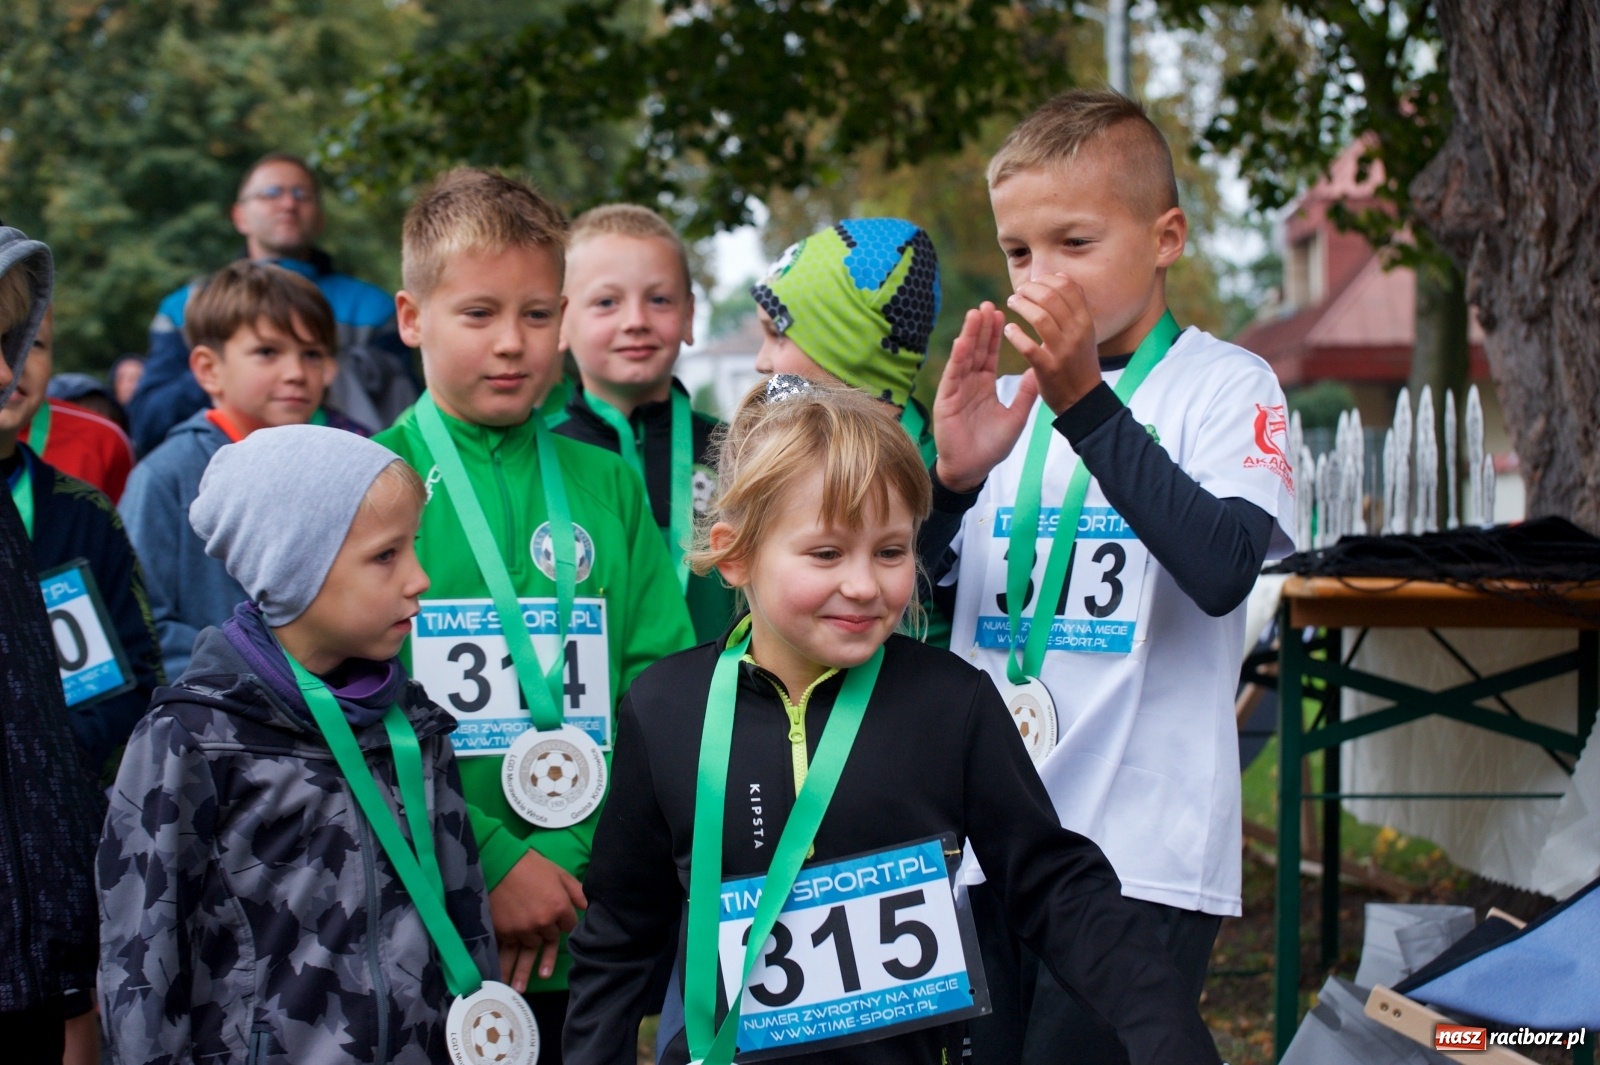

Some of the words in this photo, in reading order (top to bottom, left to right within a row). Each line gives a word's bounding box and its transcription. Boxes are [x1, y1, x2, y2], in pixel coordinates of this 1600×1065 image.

[1000, 514, 1131, 532] TE-SORT.P
[421, 610, 598, 631] TIME-SOR.PL
[982, 621, 1012, 631] NUME
[1021, 622, 1077, 633] ZTNY
[1076, 624, 1092, 634] NA
[1094, 625, 1128, 636] MECIE
[47, 609, 88, 671] 0
[996, 634, 1108, 648] WWWE-SPORT.PL
[447, 640, 586, 713] 34
[481, 722, 533, 734] ZWROT
[526, 807, 548, 823] Wrota
[570, 801, 593, 820] Gmina
[749, 783, 764, 849] KIPSTA
[720, 854, 938, 914] TIMSPORT.PL
[741, 889, 939, 1008] 315
[743, 1012, 799, 1031] NUMER
[802, 996, 882, 1021] ZWROTNY
[885, 989, 910, 1005] NA
[912, 977, 959, 998] MECIE
[769, 999, 938, 1042] WWW.TIME-SPORT.PL
